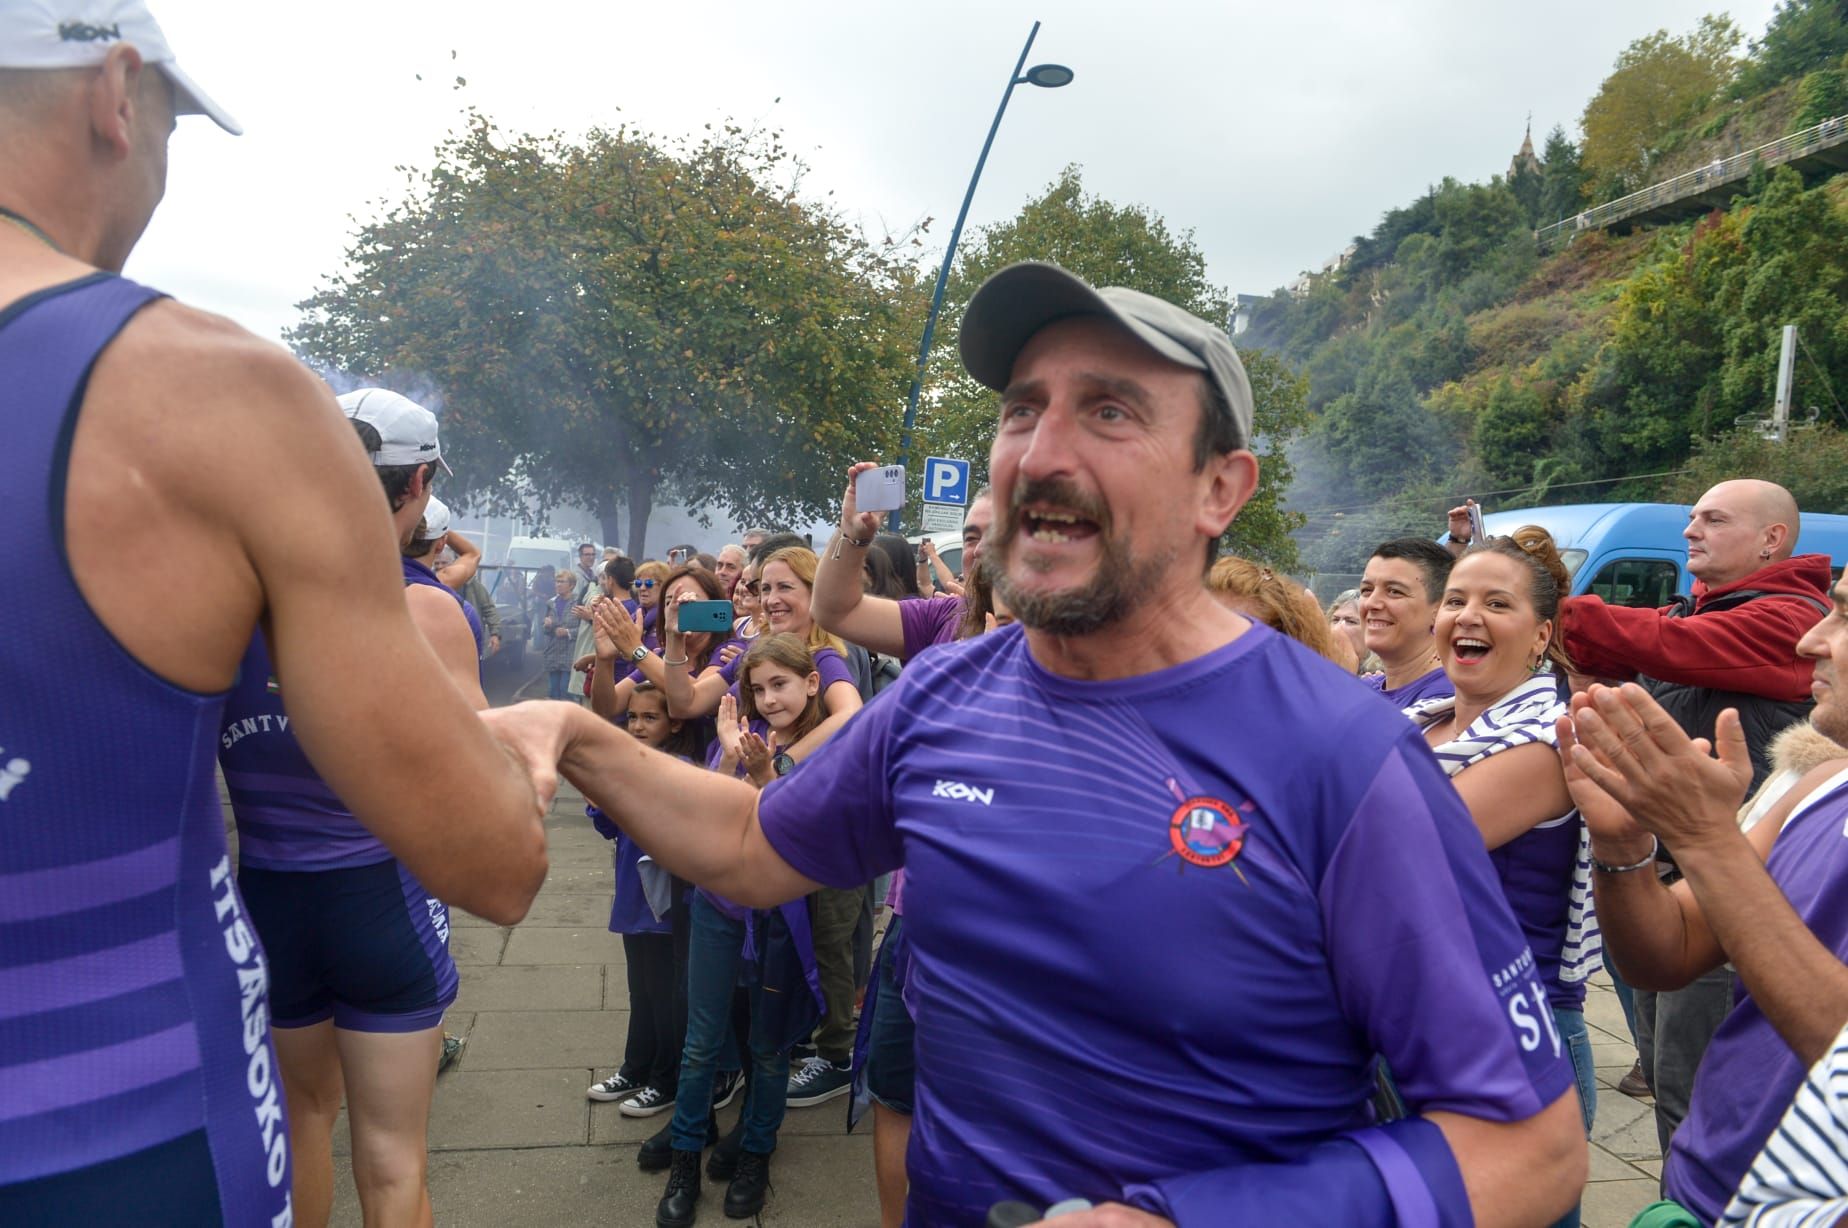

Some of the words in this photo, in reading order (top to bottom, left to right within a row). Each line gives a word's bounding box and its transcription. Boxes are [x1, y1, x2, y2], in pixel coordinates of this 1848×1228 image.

[58, 22, 121, 42] KON
[932, 463, 960, 498] P
[222, 714, 289, 749] SANTV
[932, 779, 995, 806] KON
[209, 854, 287, 1188] ITSASOKO
